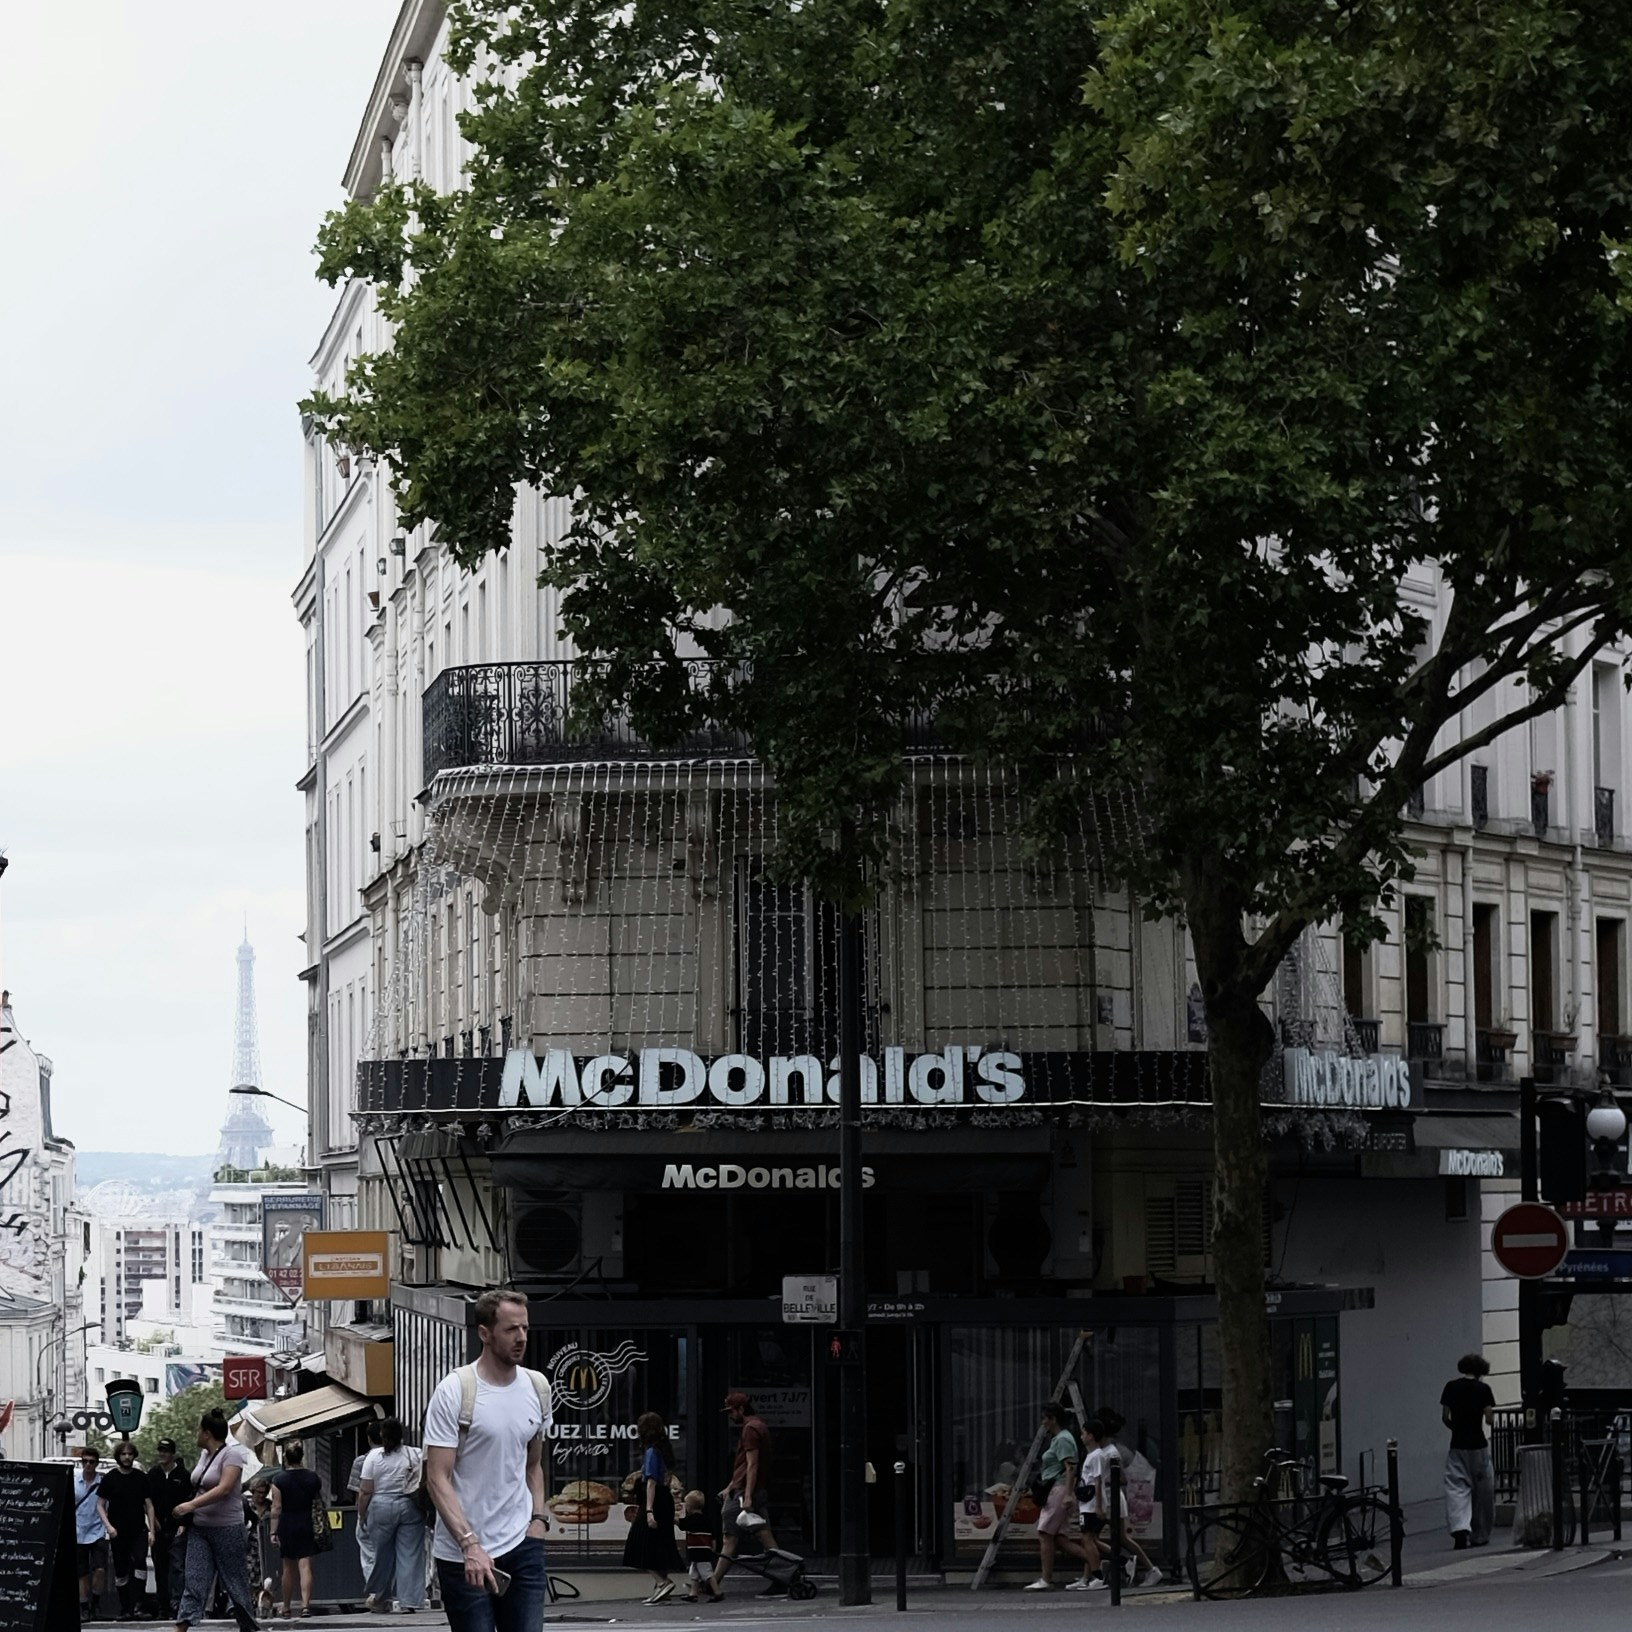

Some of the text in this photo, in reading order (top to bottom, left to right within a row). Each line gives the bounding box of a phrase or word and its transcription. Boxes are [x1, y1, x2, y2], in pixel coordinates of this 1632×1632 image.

[497, 1045, 1027, 1106] McDonald's
[1294, 1047, 1411, 1108] McDonald's
[1447, 1149, 1504, 1176] McDonald's
[661, 1164, 876, 1190] McDonalds
[1566, 1191, 1632, 1212] ETR
[783, 1303, 836, 1313] BELLEVILLE
[546, 1341, 578, 1370] NOUVEAU
[229, 1369, 261, 1388] SFR
[543, 1424, 680, 1440] UEZ LE MOE
